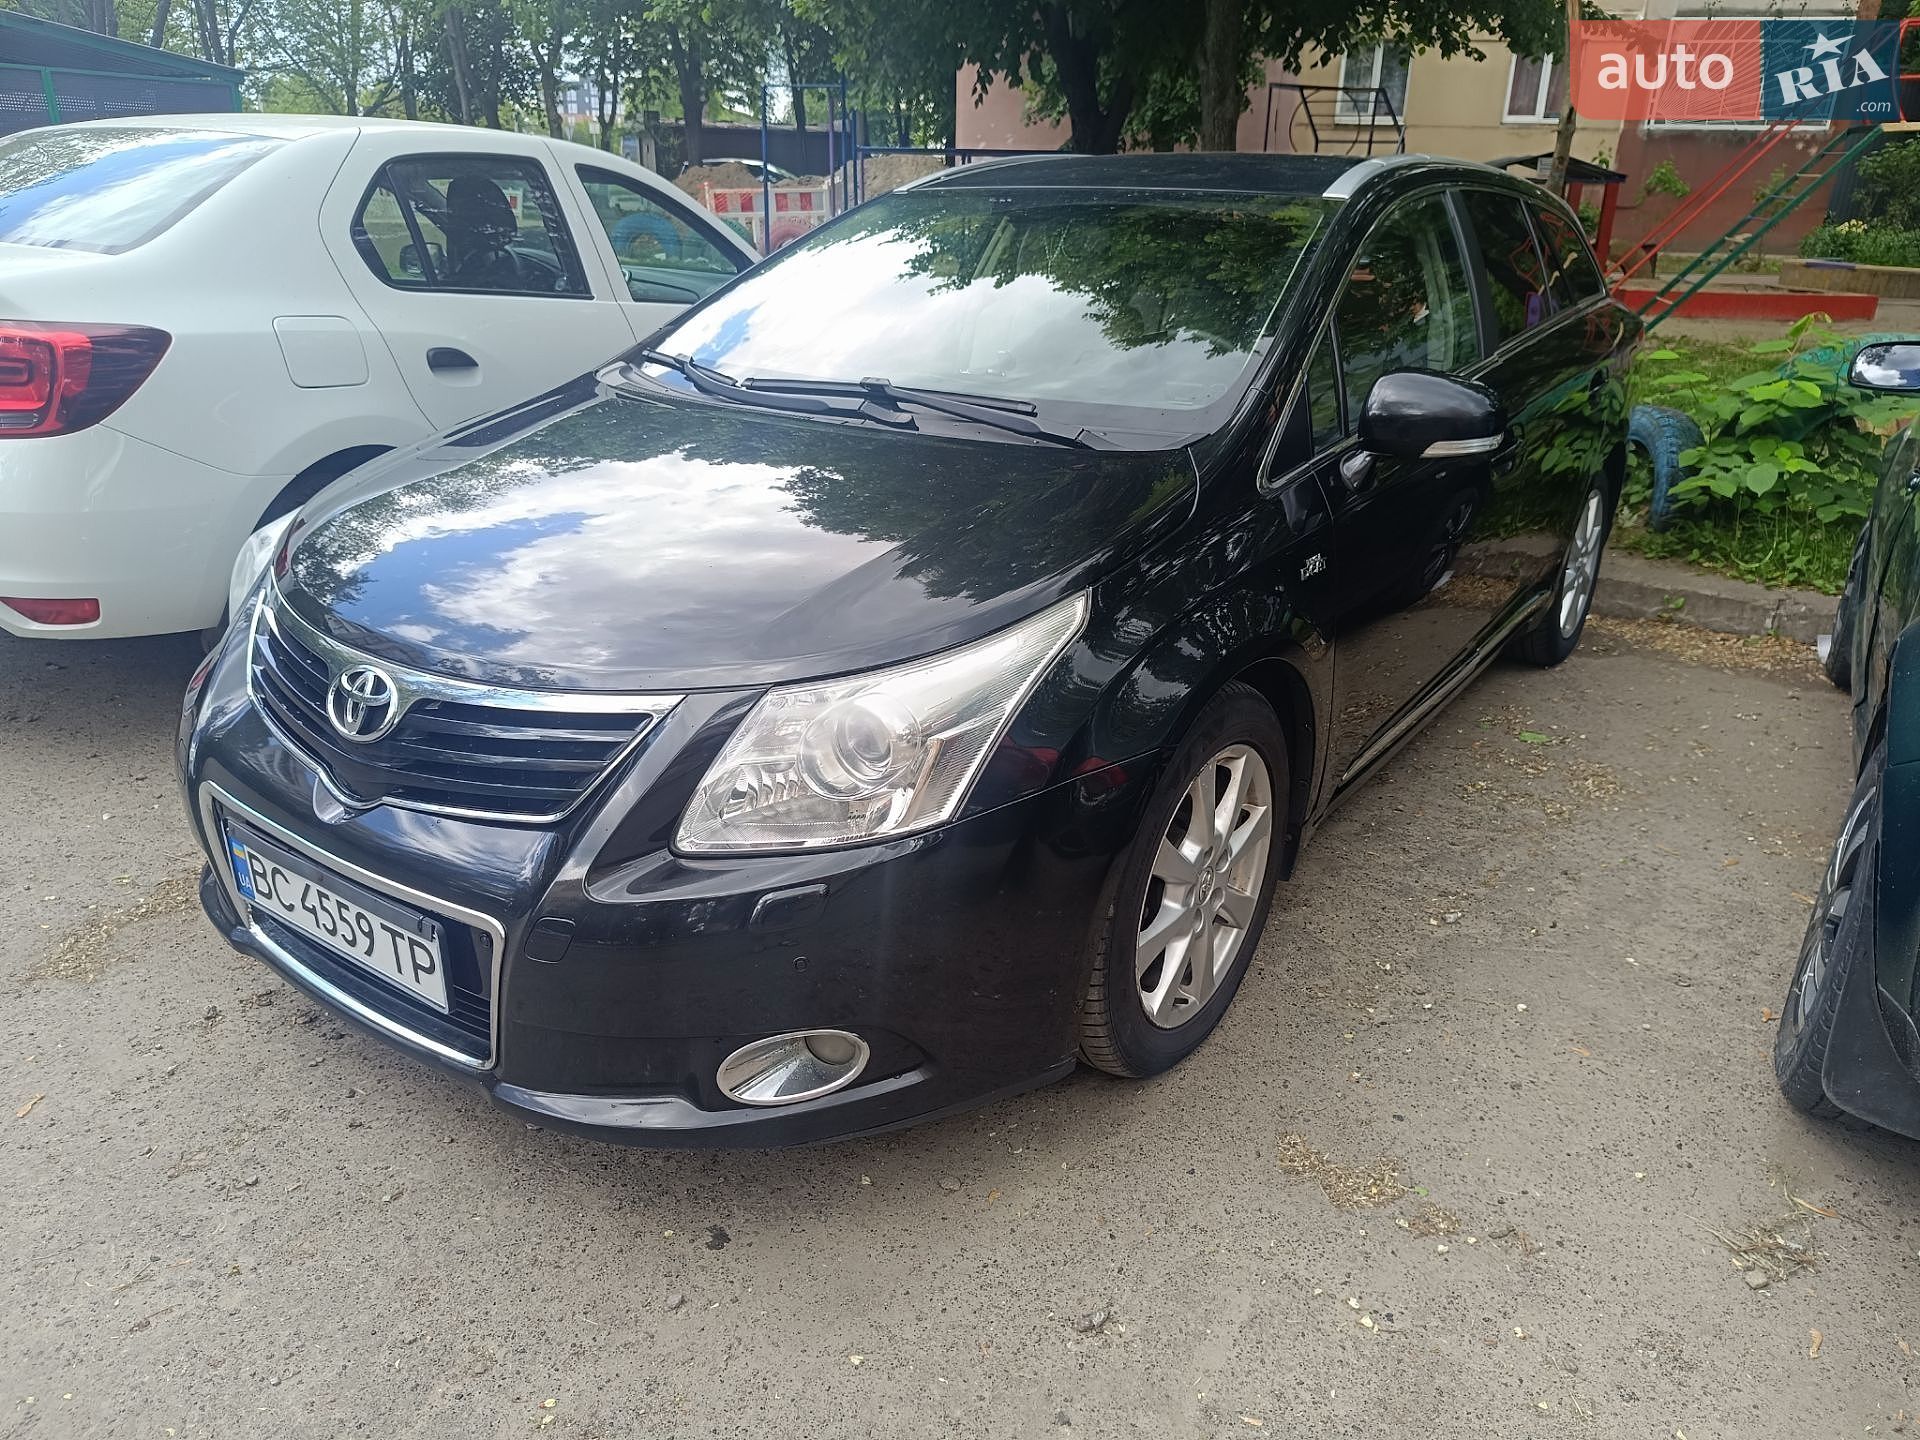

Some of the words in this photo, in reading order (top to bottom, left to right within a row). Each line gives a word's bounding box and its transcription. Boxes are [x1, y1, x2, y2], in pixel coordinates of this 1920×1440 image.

[238, 871, 252, 890] UA
[247, 850, 295, 912] BC
[301, 882, 375, 957] 4559
[380, 922, 436, 985] TP
